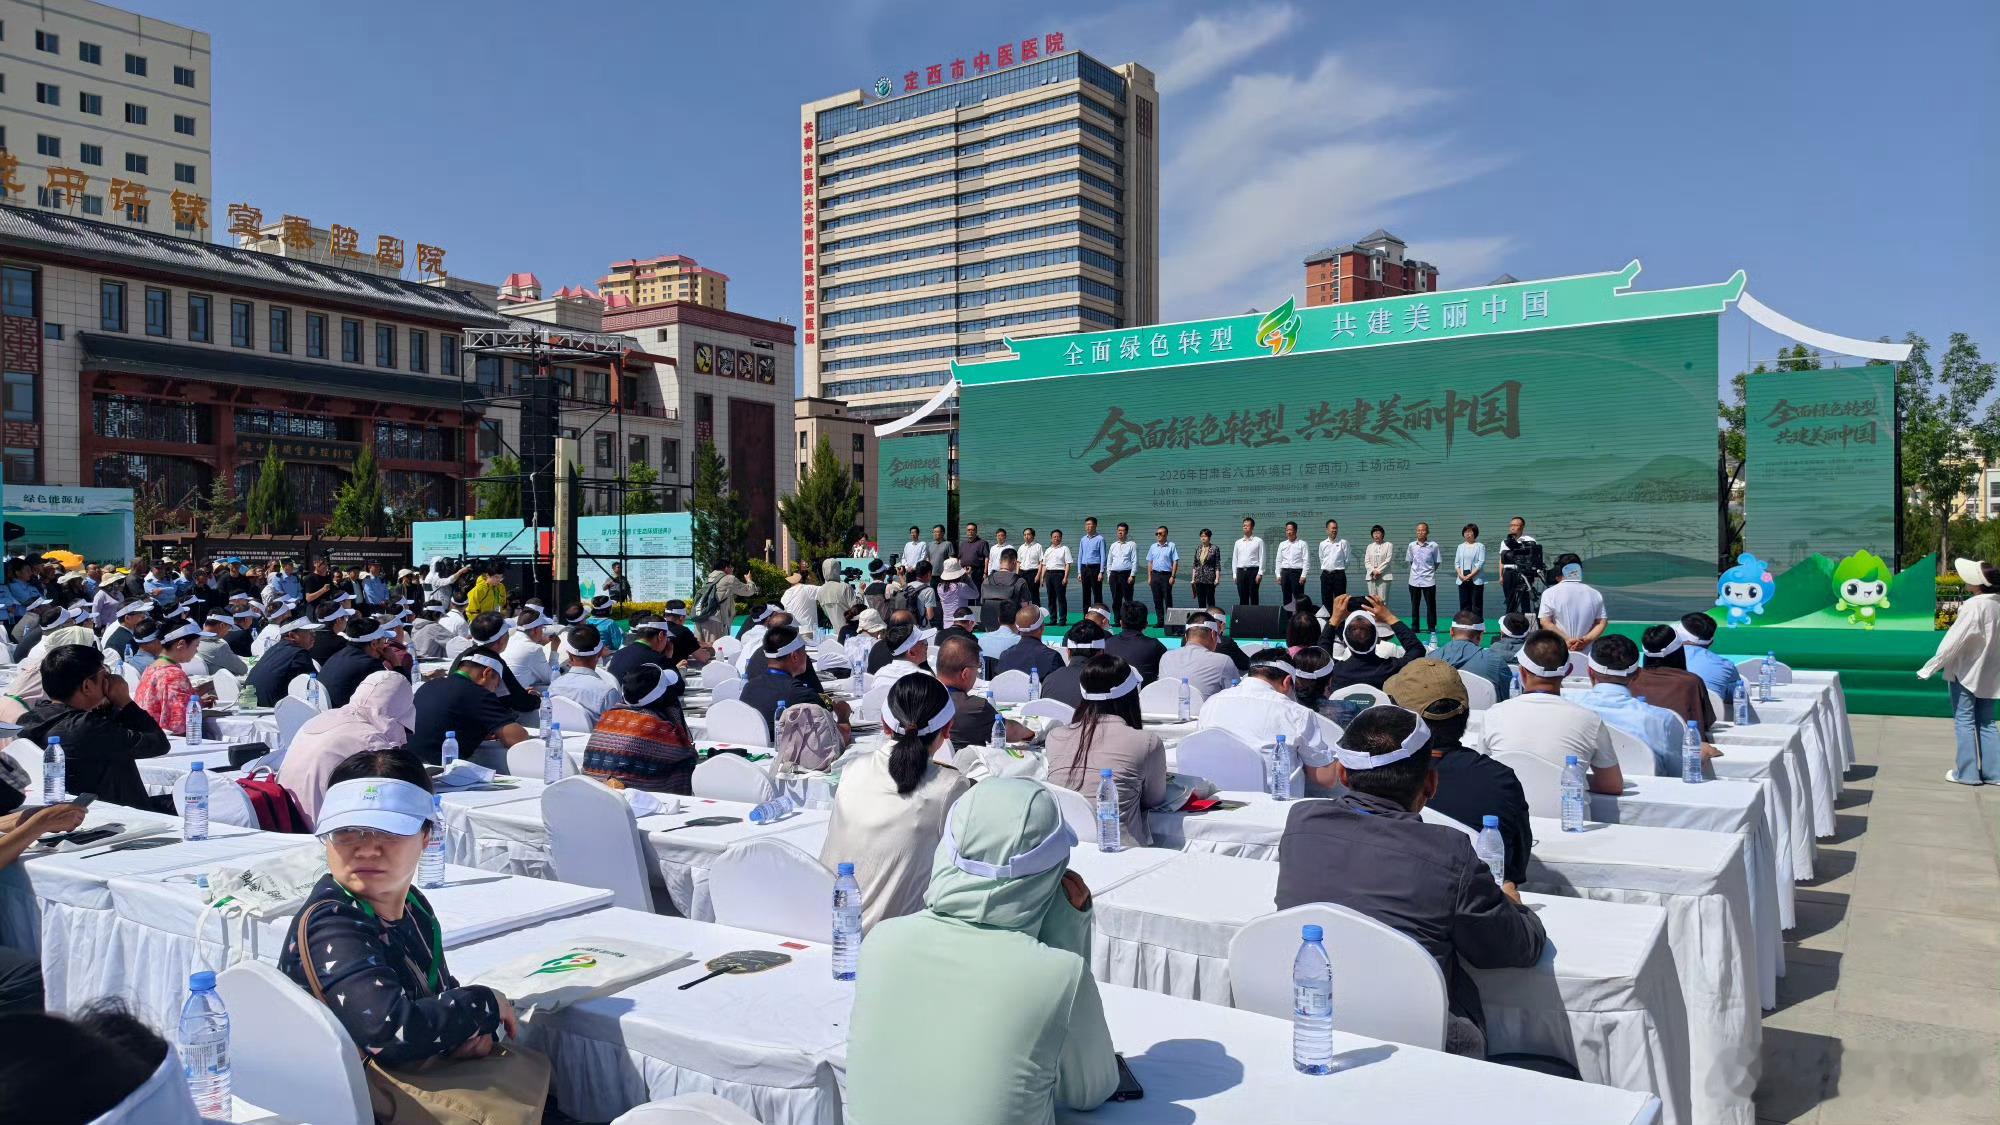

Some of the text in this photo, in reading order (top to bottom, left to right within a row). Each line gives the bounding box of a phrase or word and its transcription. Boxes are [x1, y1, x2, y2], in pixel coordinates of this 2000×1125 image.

[904, 32, 1064, 91] 定西市中医医院
[1063, 289, 1550, 367] 全面绿色转型 共建美丽中国
[1070, 380, 1523, 474] 全面绿色转型 共建美丽中国
[23, 494, 85, 505] 绿色能源展
